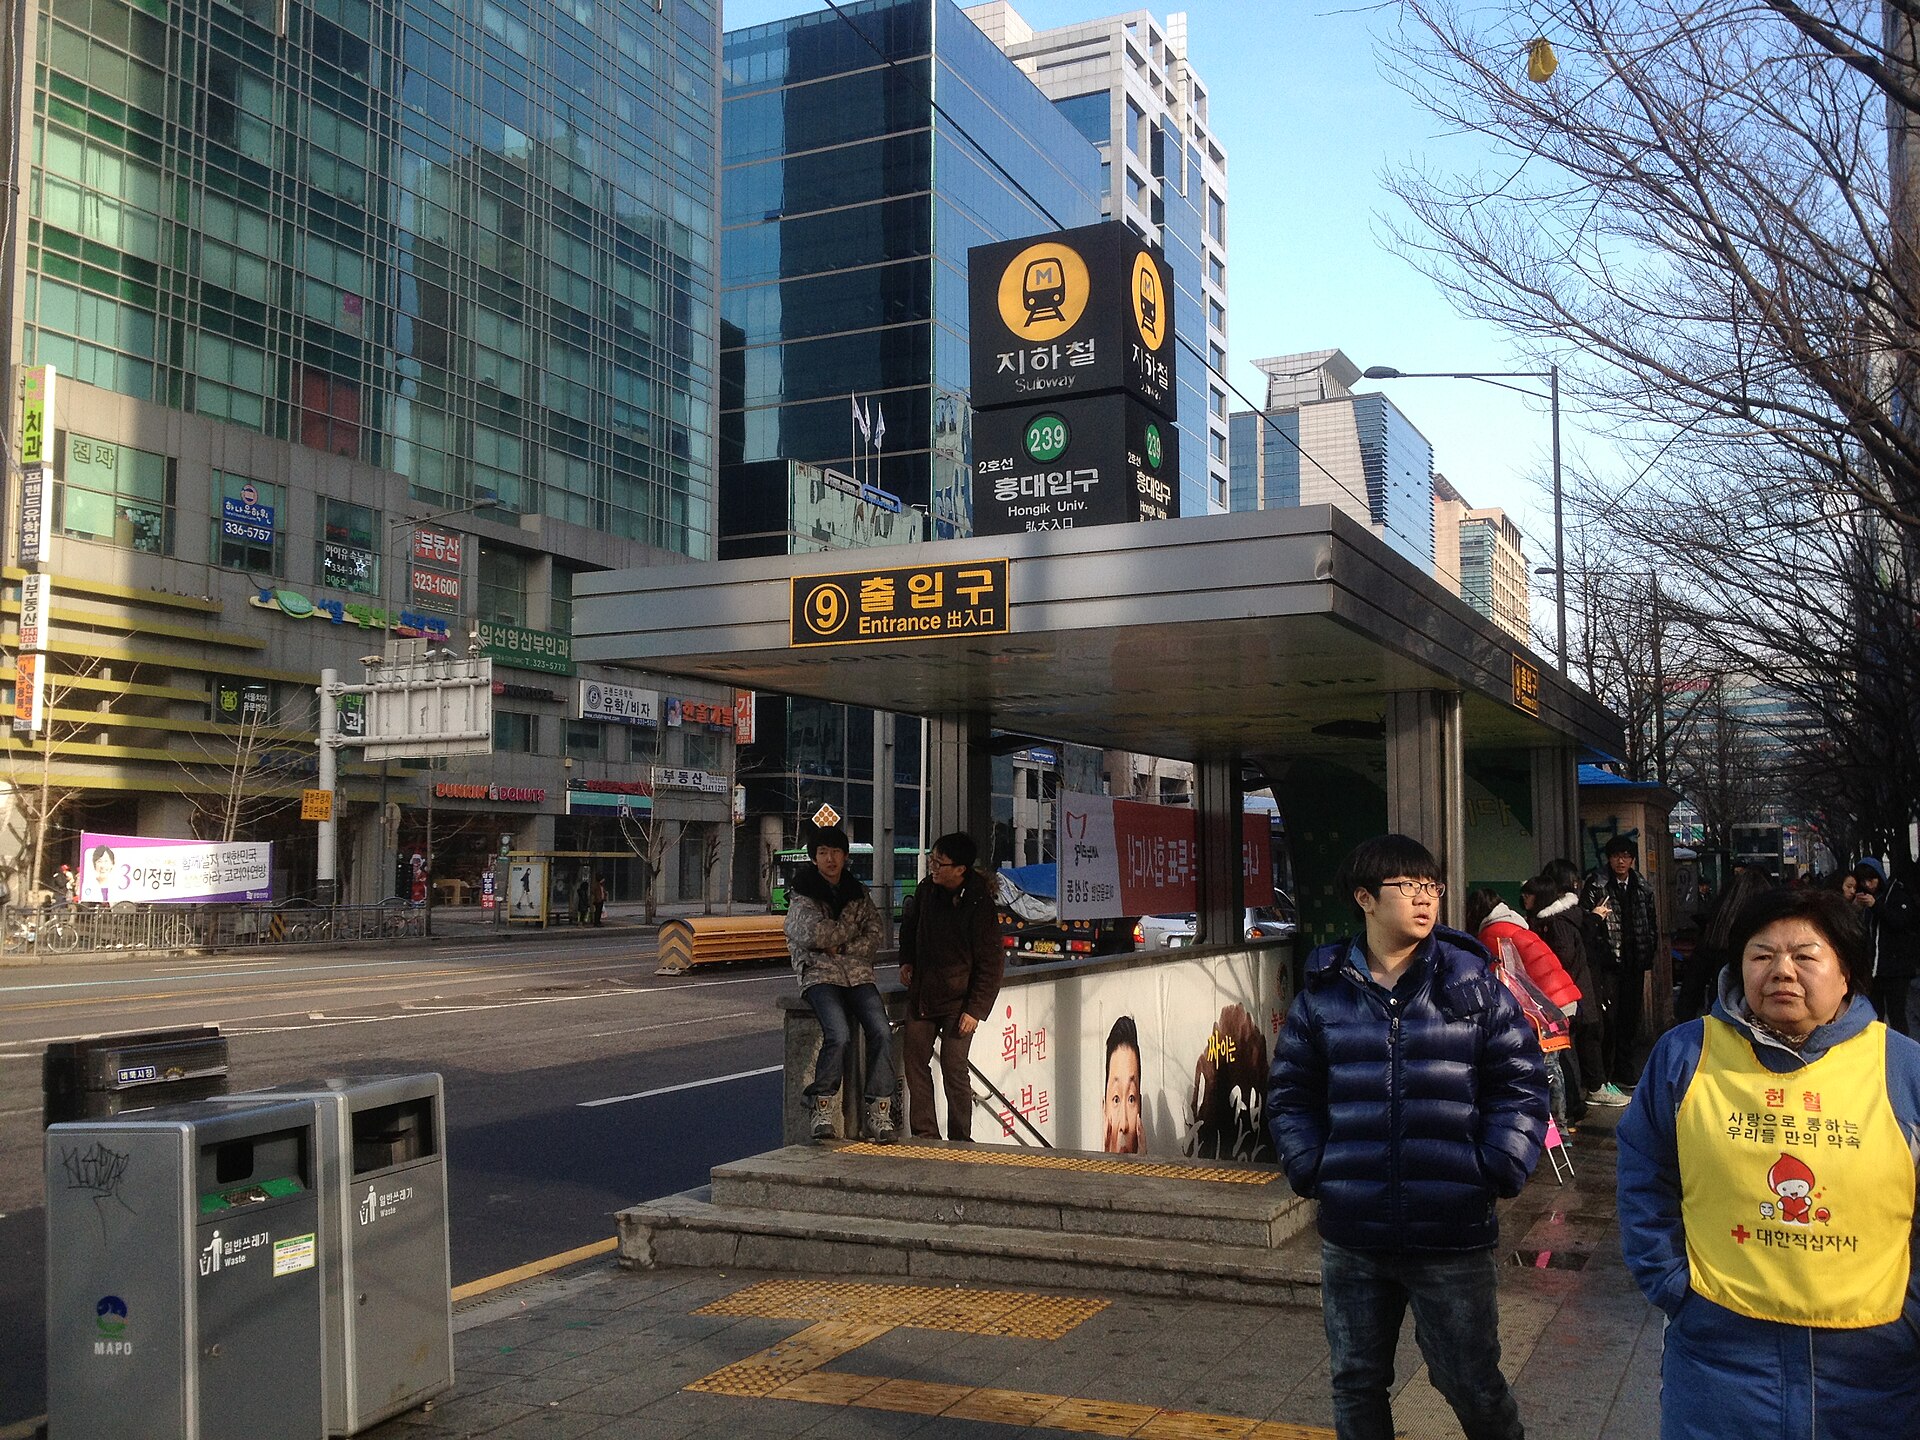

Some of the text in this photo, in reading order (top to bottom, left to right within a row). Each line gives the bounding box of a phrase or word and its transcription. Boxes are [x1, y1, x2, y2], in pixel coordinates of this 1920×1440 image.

[996, 337, 1095, 375] 지하철
[1132, 343, 1168, 390] 지하철
[1015, 373, 1076, 393] Subway
[25, 410, 42, 458] 치과
[1030, 425, 1065, 453] 239
[1147, 432, 1161, 460] 239
[978, 457, 1014, 474] 2호선
[993, 467, 1099, 501] 홍대입구
[1136, 470, 1171, 506] 홍대입구
[225, 501, 271, 525] 하나유학원
[1008, 499, 1088, 518] Hongik Univ.
[225, 522, 271, 541] 336-5757
[1025, 517, 1073, 533] 弘大入口
[325, 544, 348, 561] 아이유
[421, 531, 459, 562] 부동산
[414, 572, 458, 597] 323-1600
[859, 569, 994, 614] 출입구
[24, 583, 38, 627] 부동산
[859, 608, 994, 635] Entrance 出入口
[603, 697, 651, 717] 유학/비자
[738, 696, 752, 736] 가발
[663, 770, 702, 787] 부동산
[435, 783, 488, 799] DUNKIN'
[499, 786, 546, 803] DONUTS
[222, 848, 257, 866] 대한민국
[133, 868, 176, 890] 이정희
[224, 864, 267, 884] 코리아연방
[1207, 1030, 1236, 1070] 싸이는
[1728, 1112, 1858, 1134] 사랑으로 통하는
[1726, 1126, 1861, 1149] 우리들 만의 약속
[380, 1187, 413, 1207] 일반쓰레기
[380, 1207, 396, 1217] Waste
[224, 1231, 269, 1255] 일반쓰레기
[1757, 1229, 1858, 1252] 대한적십자사
[224, 1254, 246, 1267] Waste
[94, 1342, 132, 1356] MAPO
